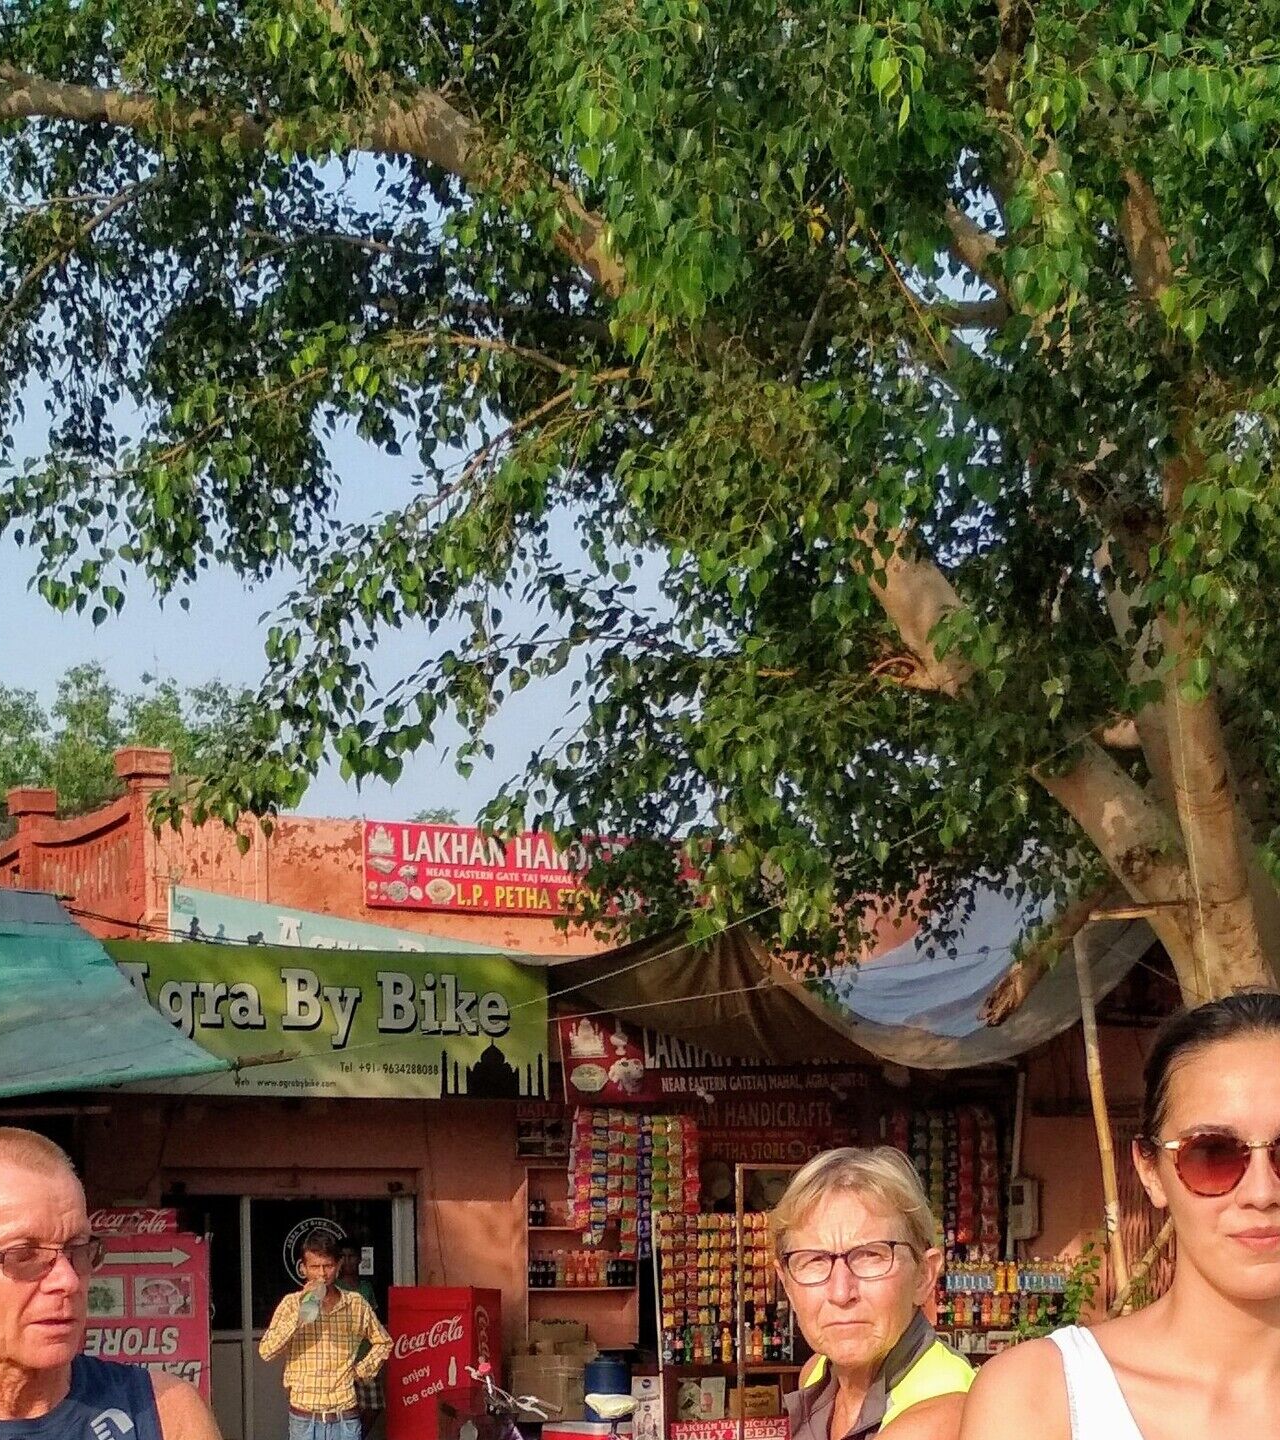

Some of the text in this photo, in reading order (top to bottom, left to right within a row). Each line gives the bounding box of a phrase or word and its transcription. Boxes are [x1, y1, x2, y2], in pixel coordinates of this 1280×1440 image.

[402, 829, 506, 867] LAKHAN
[454, 869, 493, 881] EASTERN
[496, 871, 520, 882] GATE
[522, 873, 537, 885] TAJ
[495, 886, 551, 910] PETHA
[280, 968, 360, 1048] By
[376, 972, 510, 1037] Bike
[661, 1076, 686, 1092] NEAR
[689, 1075, 726, 1091] EASTERN
[84, 1327, 179, 1356] STORE
[394, 1314, 464, 1359] Coca-Cola
[402, 1365, 431, 1385] enjoy
[402, 1379, 444, 1406] ice cold
[676, 1421, 718, 1432] LAKHAN
[676, 1430, 726, 1440] DAILY
